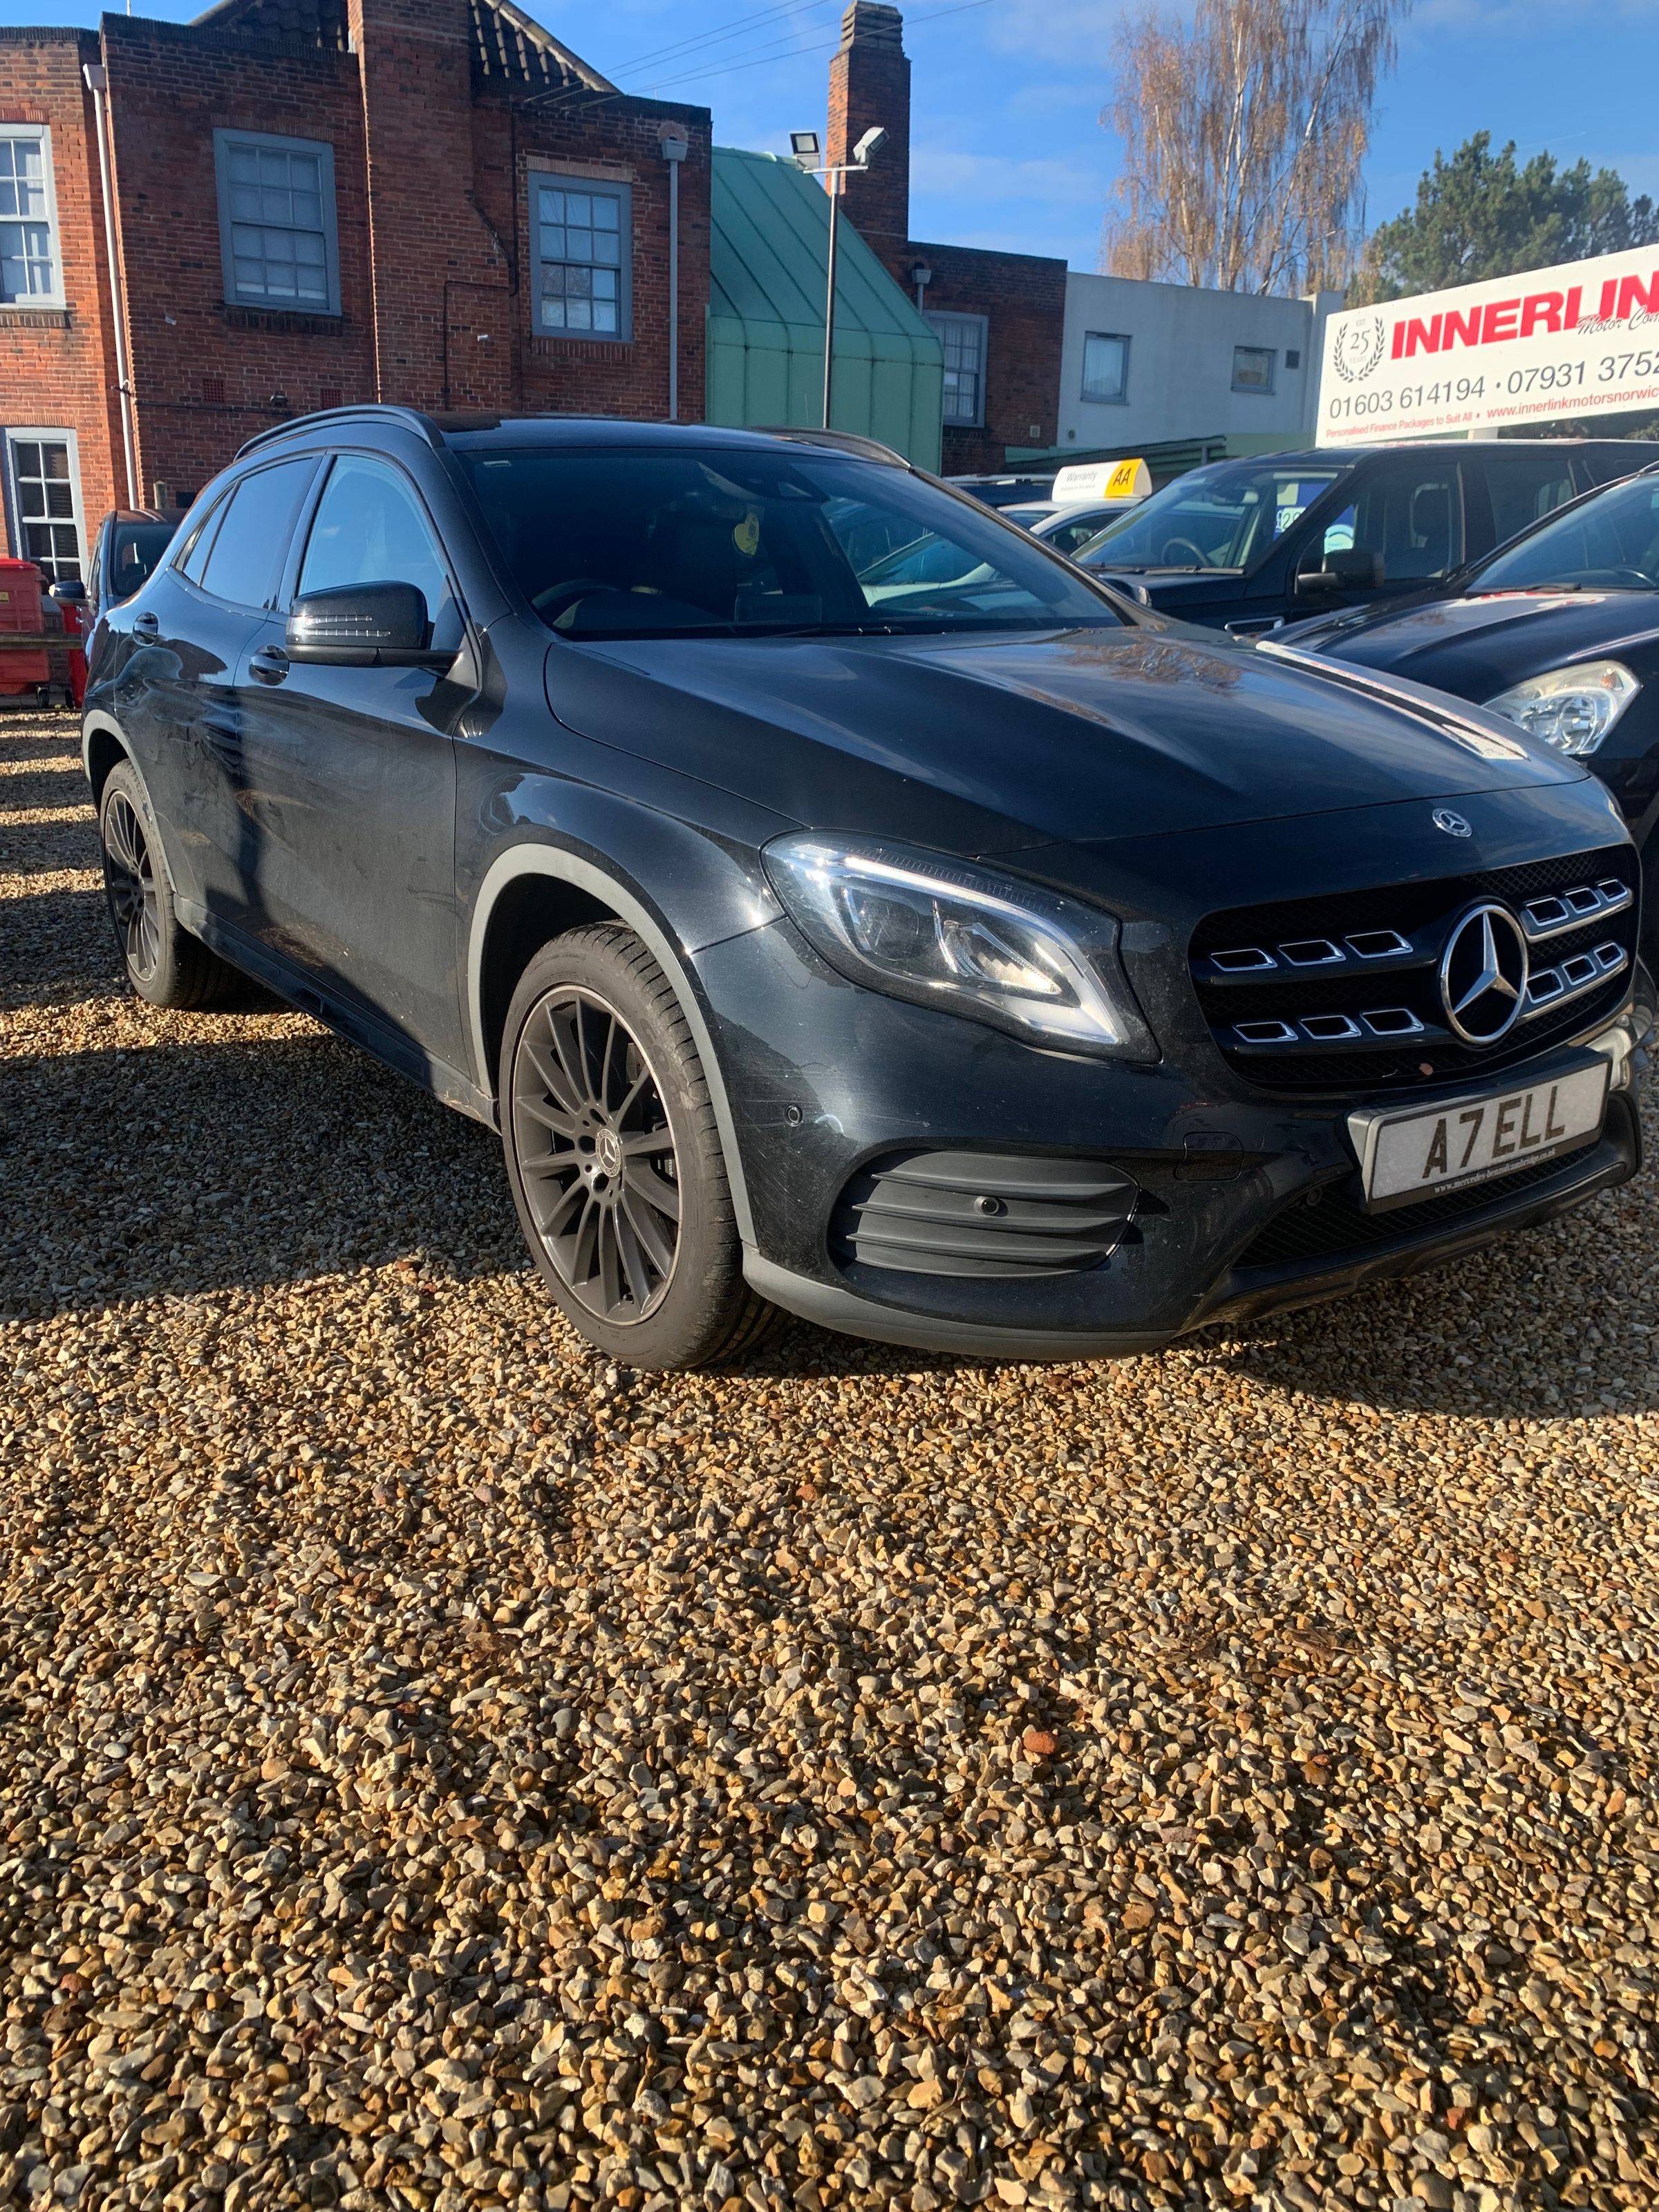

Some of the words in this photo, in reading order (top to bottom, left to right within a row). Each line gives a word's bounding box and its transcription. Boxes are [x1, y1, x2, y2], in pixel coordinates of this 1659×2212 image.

[1577, 314, 1623, 335] Motor
[1350, 328, 1371, 355] 25
[1329, 389, 1394, 419] 01603
[1400, 375, 1485, 409] 614194
[1507, 360, 1586, 395] 07931
[1325, 424, 1369, 438] Personalised
[1369, 421, 1397, 433] Finance
[1398, 418, 1434, 431] Packages
[1436, 415, 1444, 424] to
[1445, 413, 1461, 424] Suit
[1462, 411, 1472, 422] All
[1066, 471, 1098, 482] Warranty
[1113, 467, 1132, 486] AA
[1422, 1085, 1565, 1179] A7ELL
